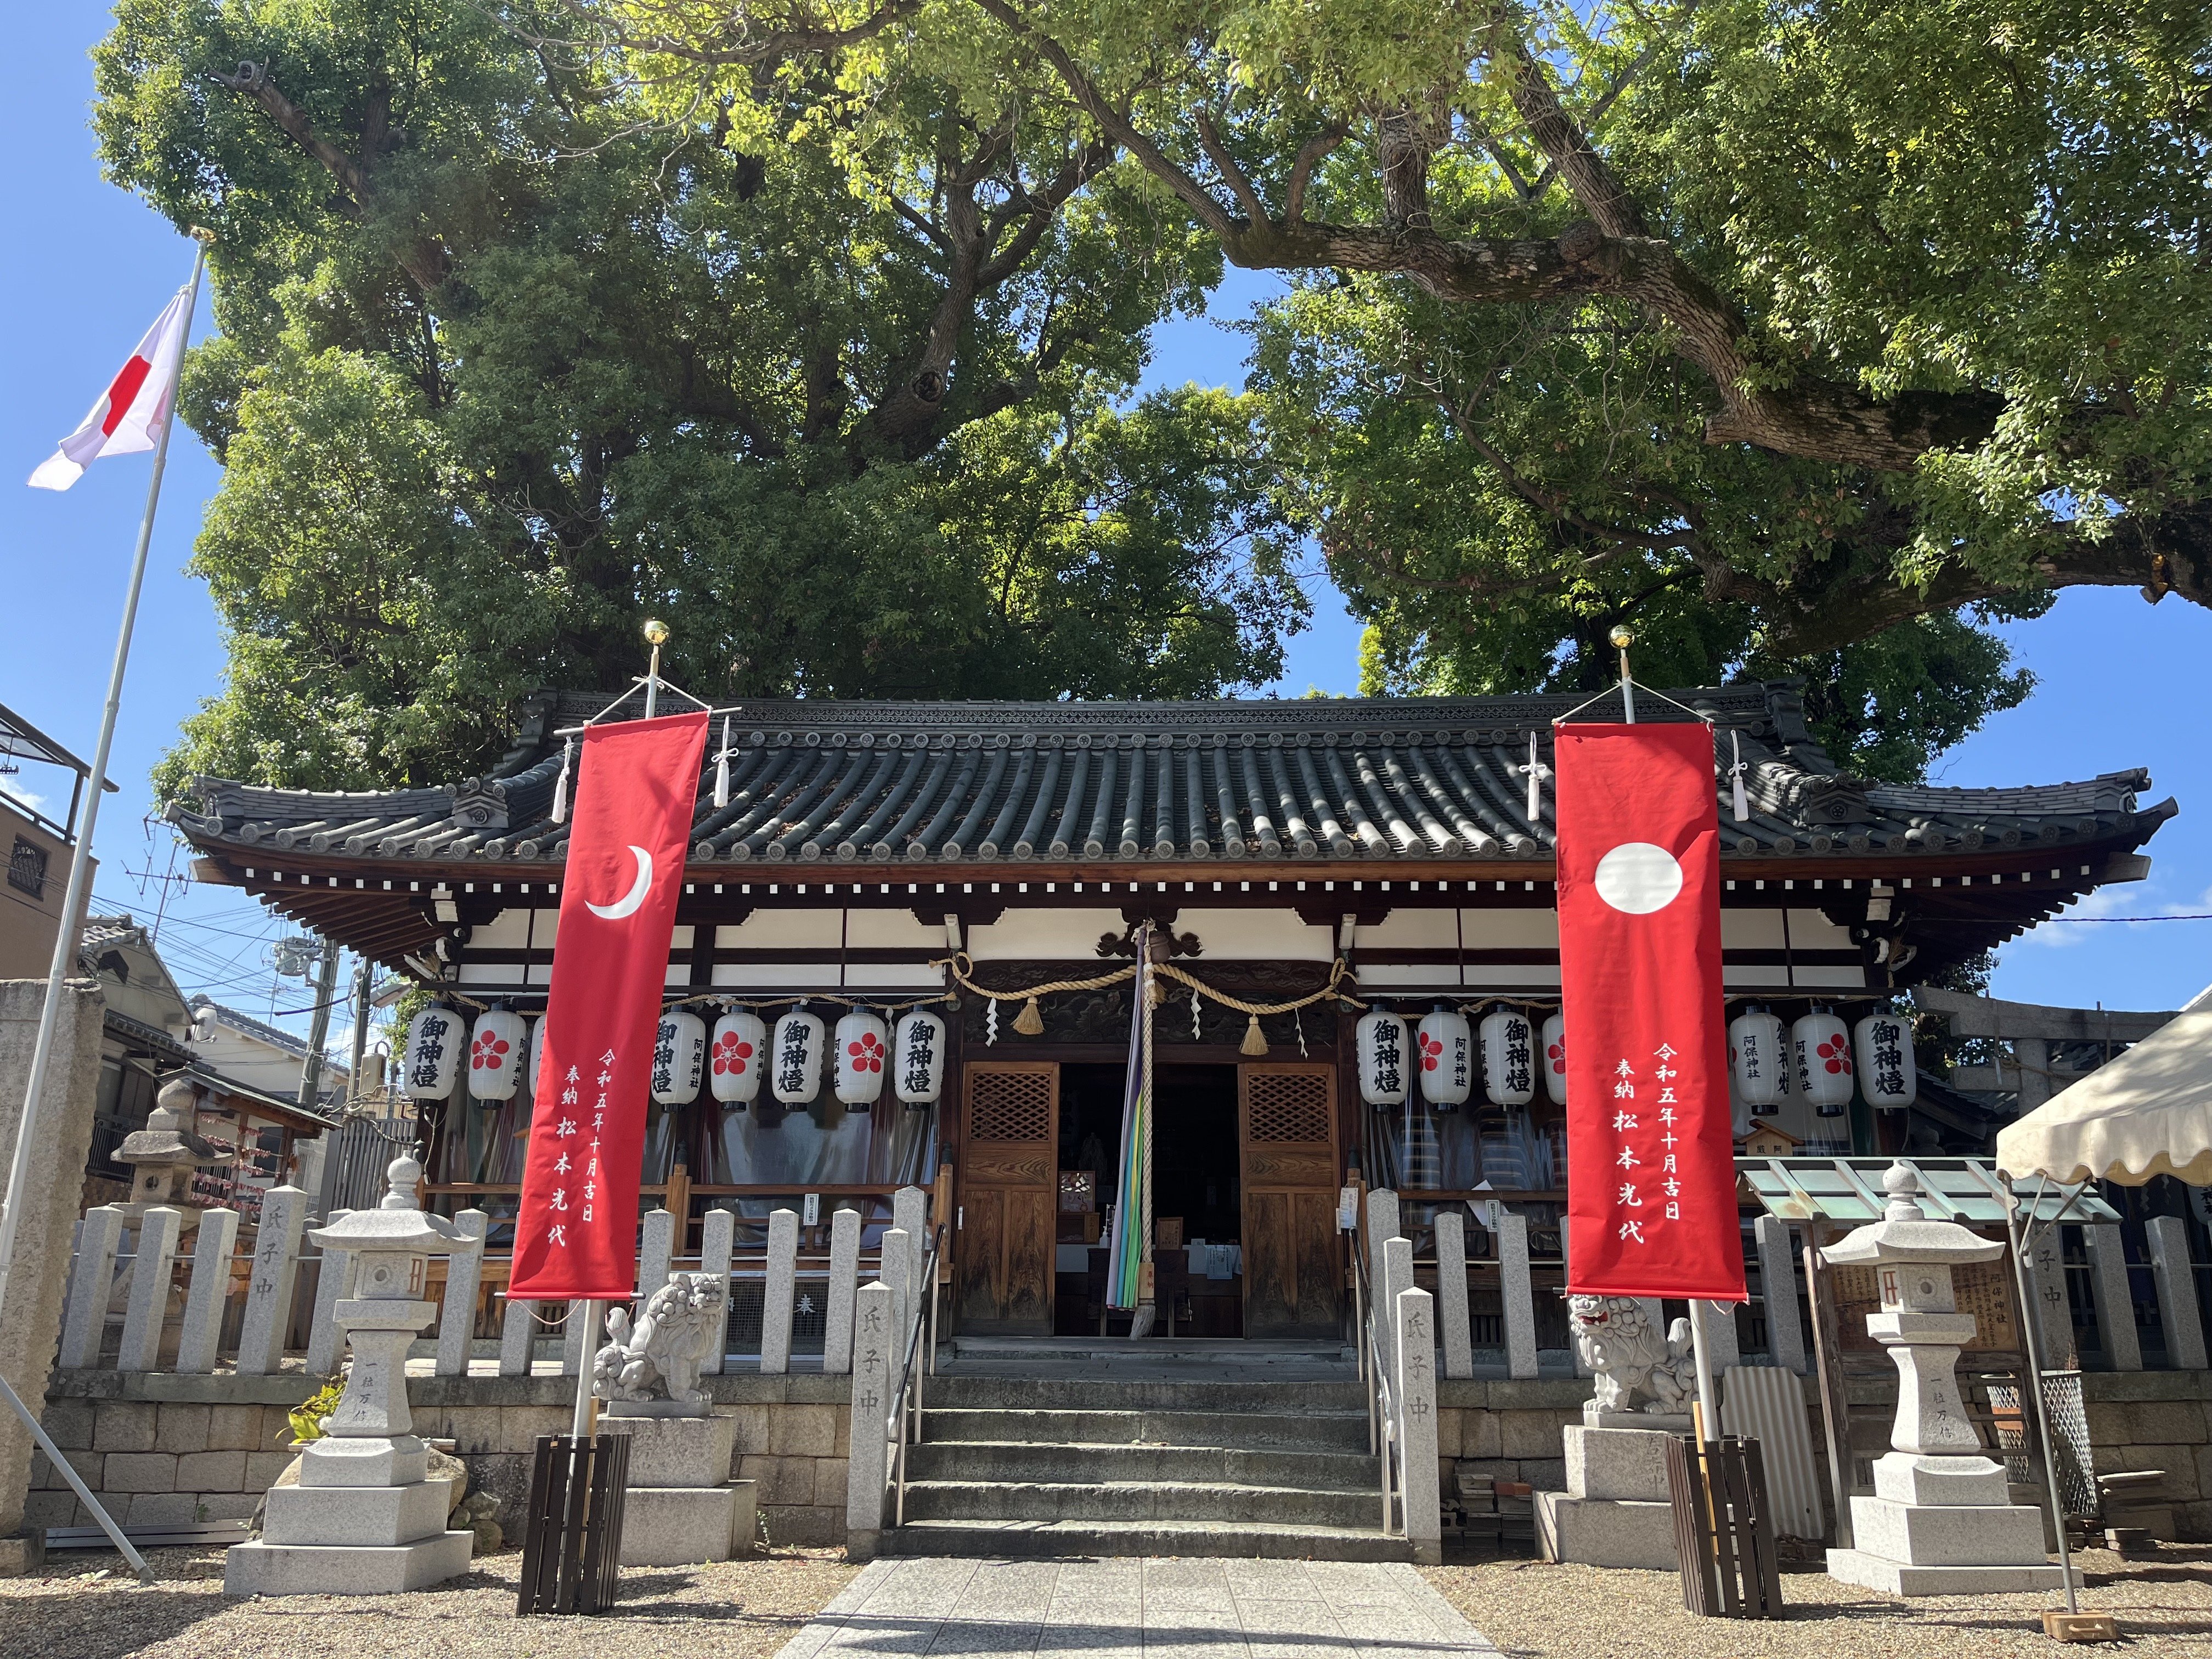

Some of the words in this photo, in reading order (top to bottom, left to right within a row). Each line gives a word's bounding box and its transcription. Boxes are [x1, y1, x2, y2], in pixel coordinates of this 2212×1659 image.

[410, 1015, 449, 1088] 御神燈
[689, 1038, 703, 1088] 阿保神社
[778, 1020, 810, 1093] 御神燈
[904, 1019, 935, 1093] 御神燈
[1373, 1019, 1401, 1094] 御神燈
[1454, 1037, 1467, 1087] 阿保神社
[1504, 1018, 1531, 1093] 御神燈
[1743, 1035, 1761, 1080] 阿保神社
[1796, 1041, 1813, 1092] 阿保神社
[1870, 1020, 1906, 1095] 御神燈
[583, 1048, 616, 1222] 令和五年十月吉日
[1653, 1042, 1681, 1220] 令和五年十月吉日
[256, 1205, 283, 1301] 氏子中
[860, 1306, 881, 1417] 氏子中
[1408, 1311, 1429, 1423] 氏子中
